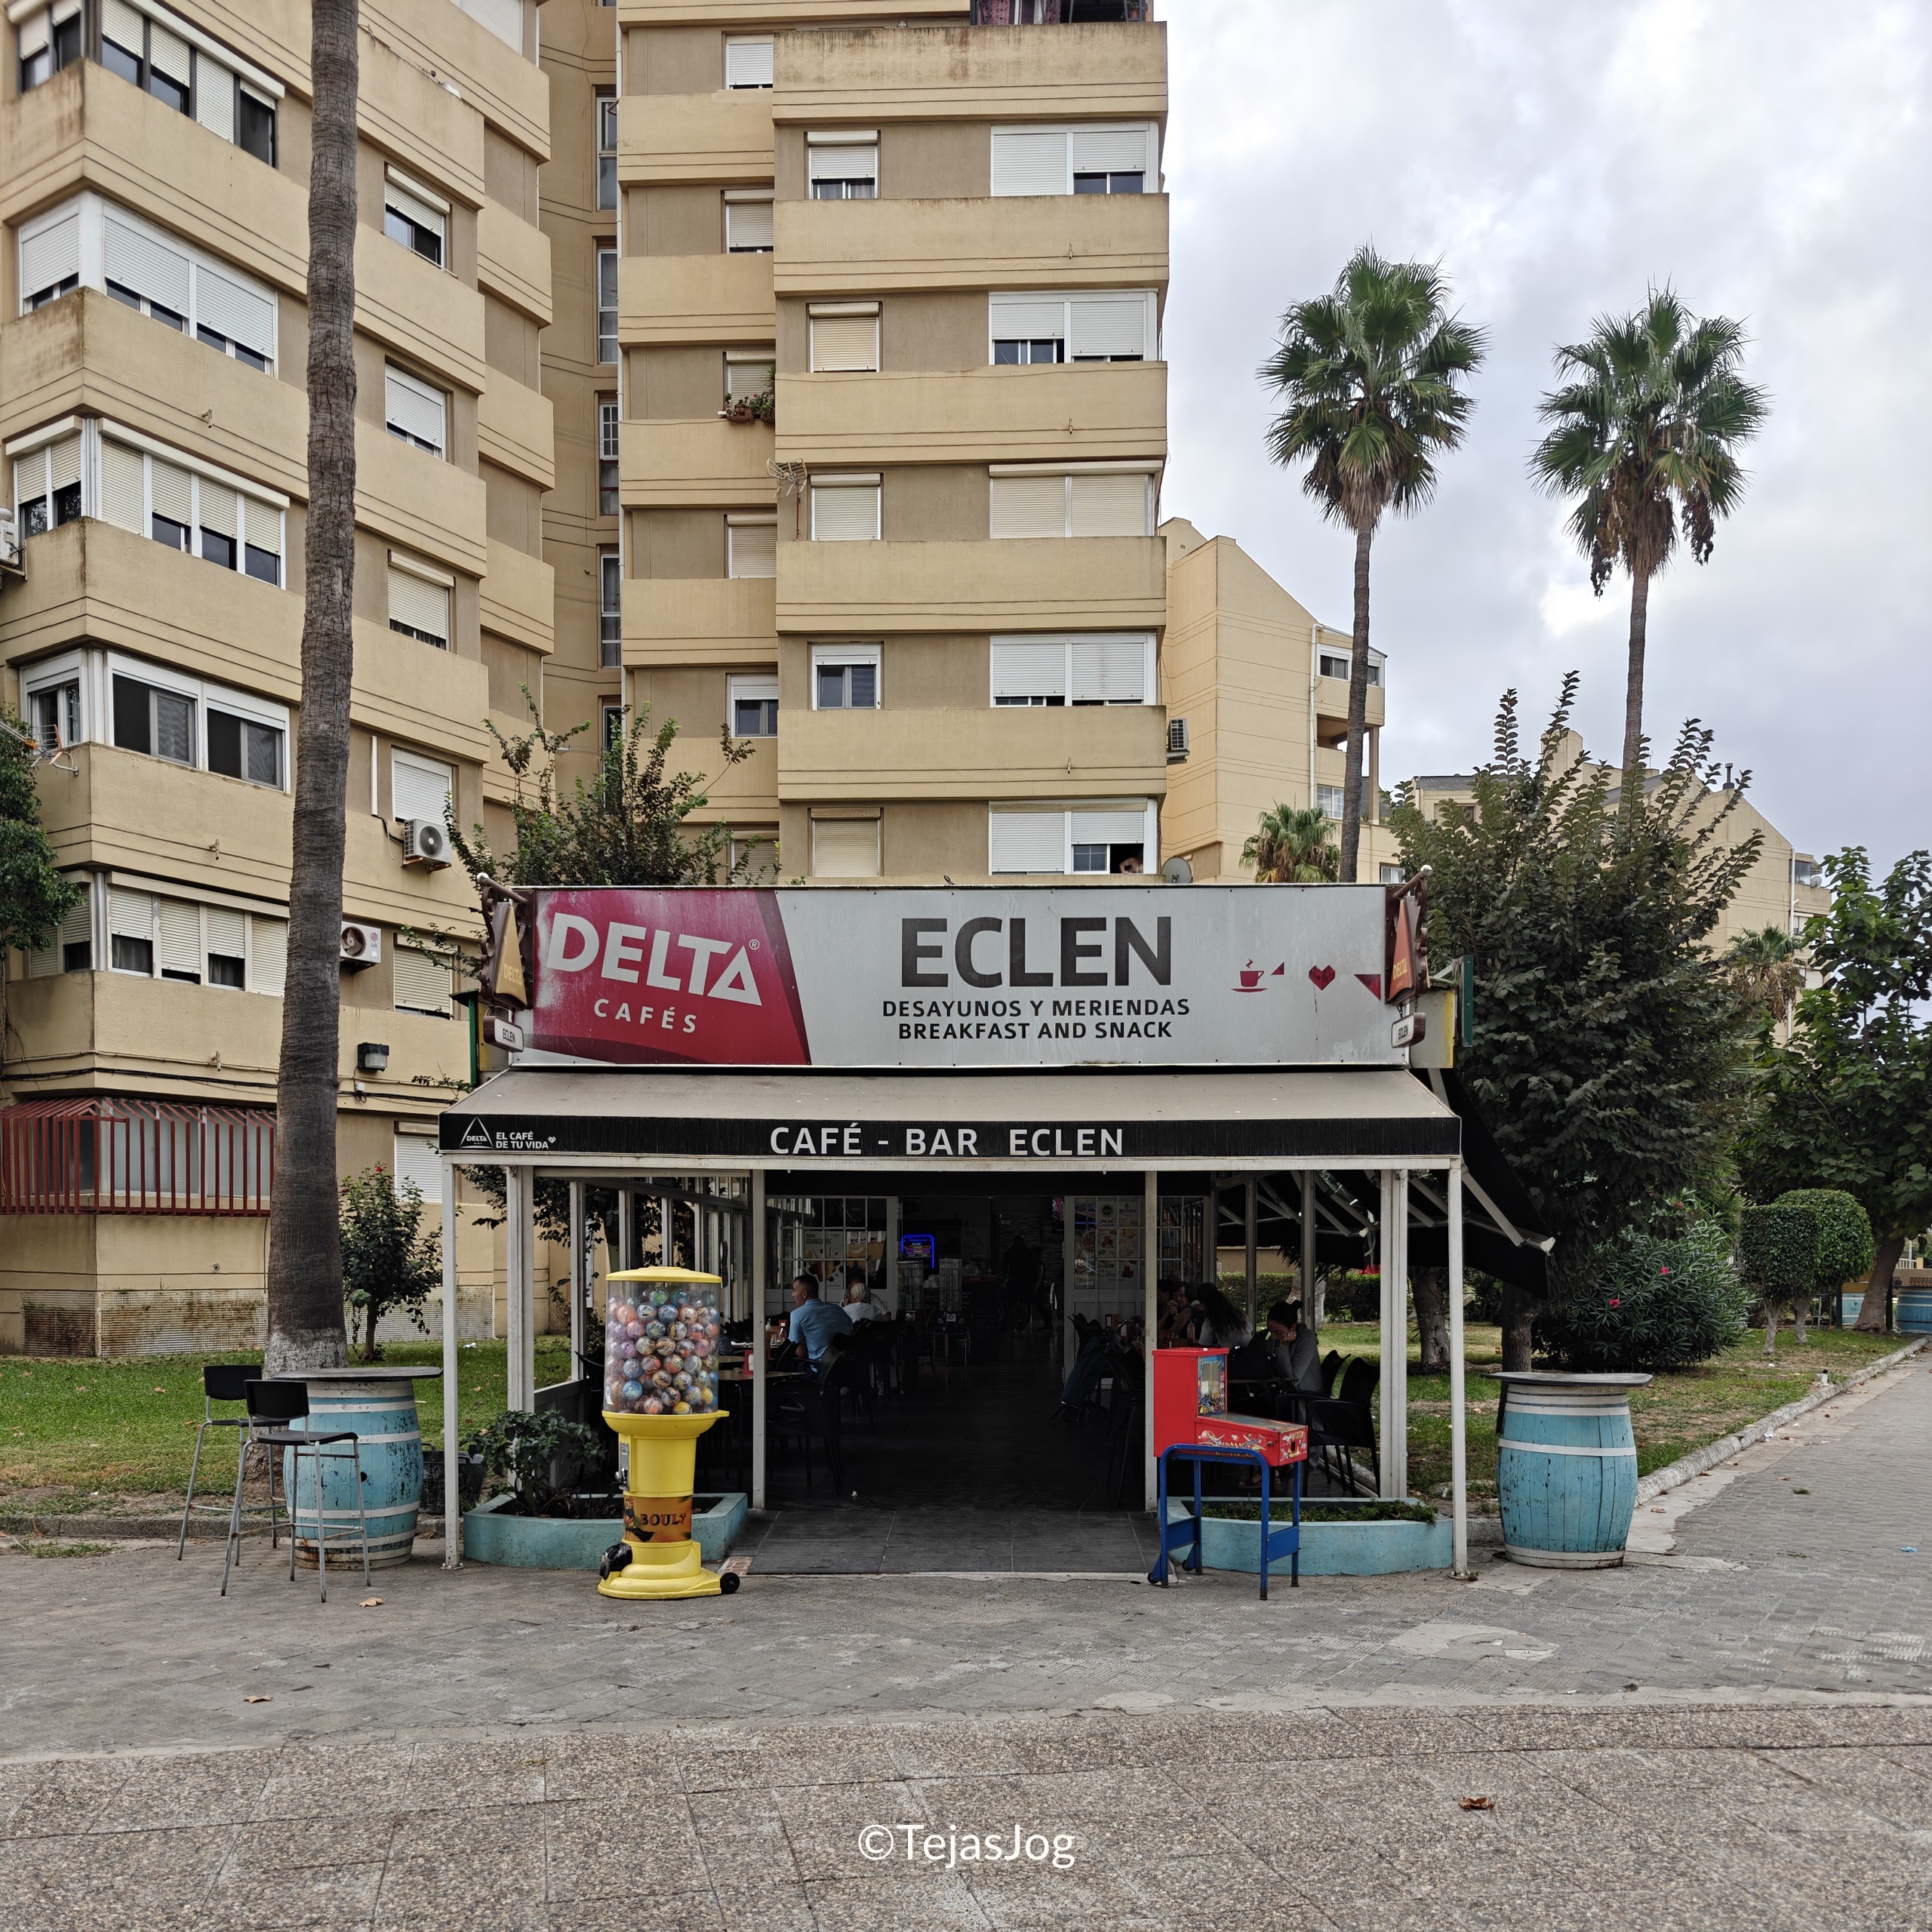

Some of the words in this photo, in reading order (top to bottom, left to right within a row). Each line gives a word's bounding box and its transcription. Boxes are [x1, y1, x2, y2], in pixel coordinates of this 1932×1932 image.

[902, 916, 1171, 988] ECLEN
[503, 962, 522, 986] DELTA
[1393, 958, 1407, 980] DELTA
[595, 999, 697, 1033] CAFÉS
[883, 1000, 1021, 1017] DESAYUNOS
[1029, 1000, 1044, 1017] Y
[1052, 998, 1190, 1017] MERIENDAS
[503, 1028, 515, 1043] ECLEN
[899, 1023, 1030, 1040] BREAKFAST
[1037, 1023, 1087, 1039] AND
[1095, 1021, 1173, 1039] SNACK
[496, 1132, 508, 1140] EL
[509, 1131, 534, 1140] CAFÉ
[496, 1140, 509, 1149] DE
[510, 1140, 524, 1149] TU
[525, 1140, 549, 1149] VIDA
[770, 1122, 863, 1156] CAFÉ
[906, 1128, 978, 1156] BAR
[1010, 1128, 1123, 1156] ECLEN
[640, 1513, 687, 1526] BOULY
